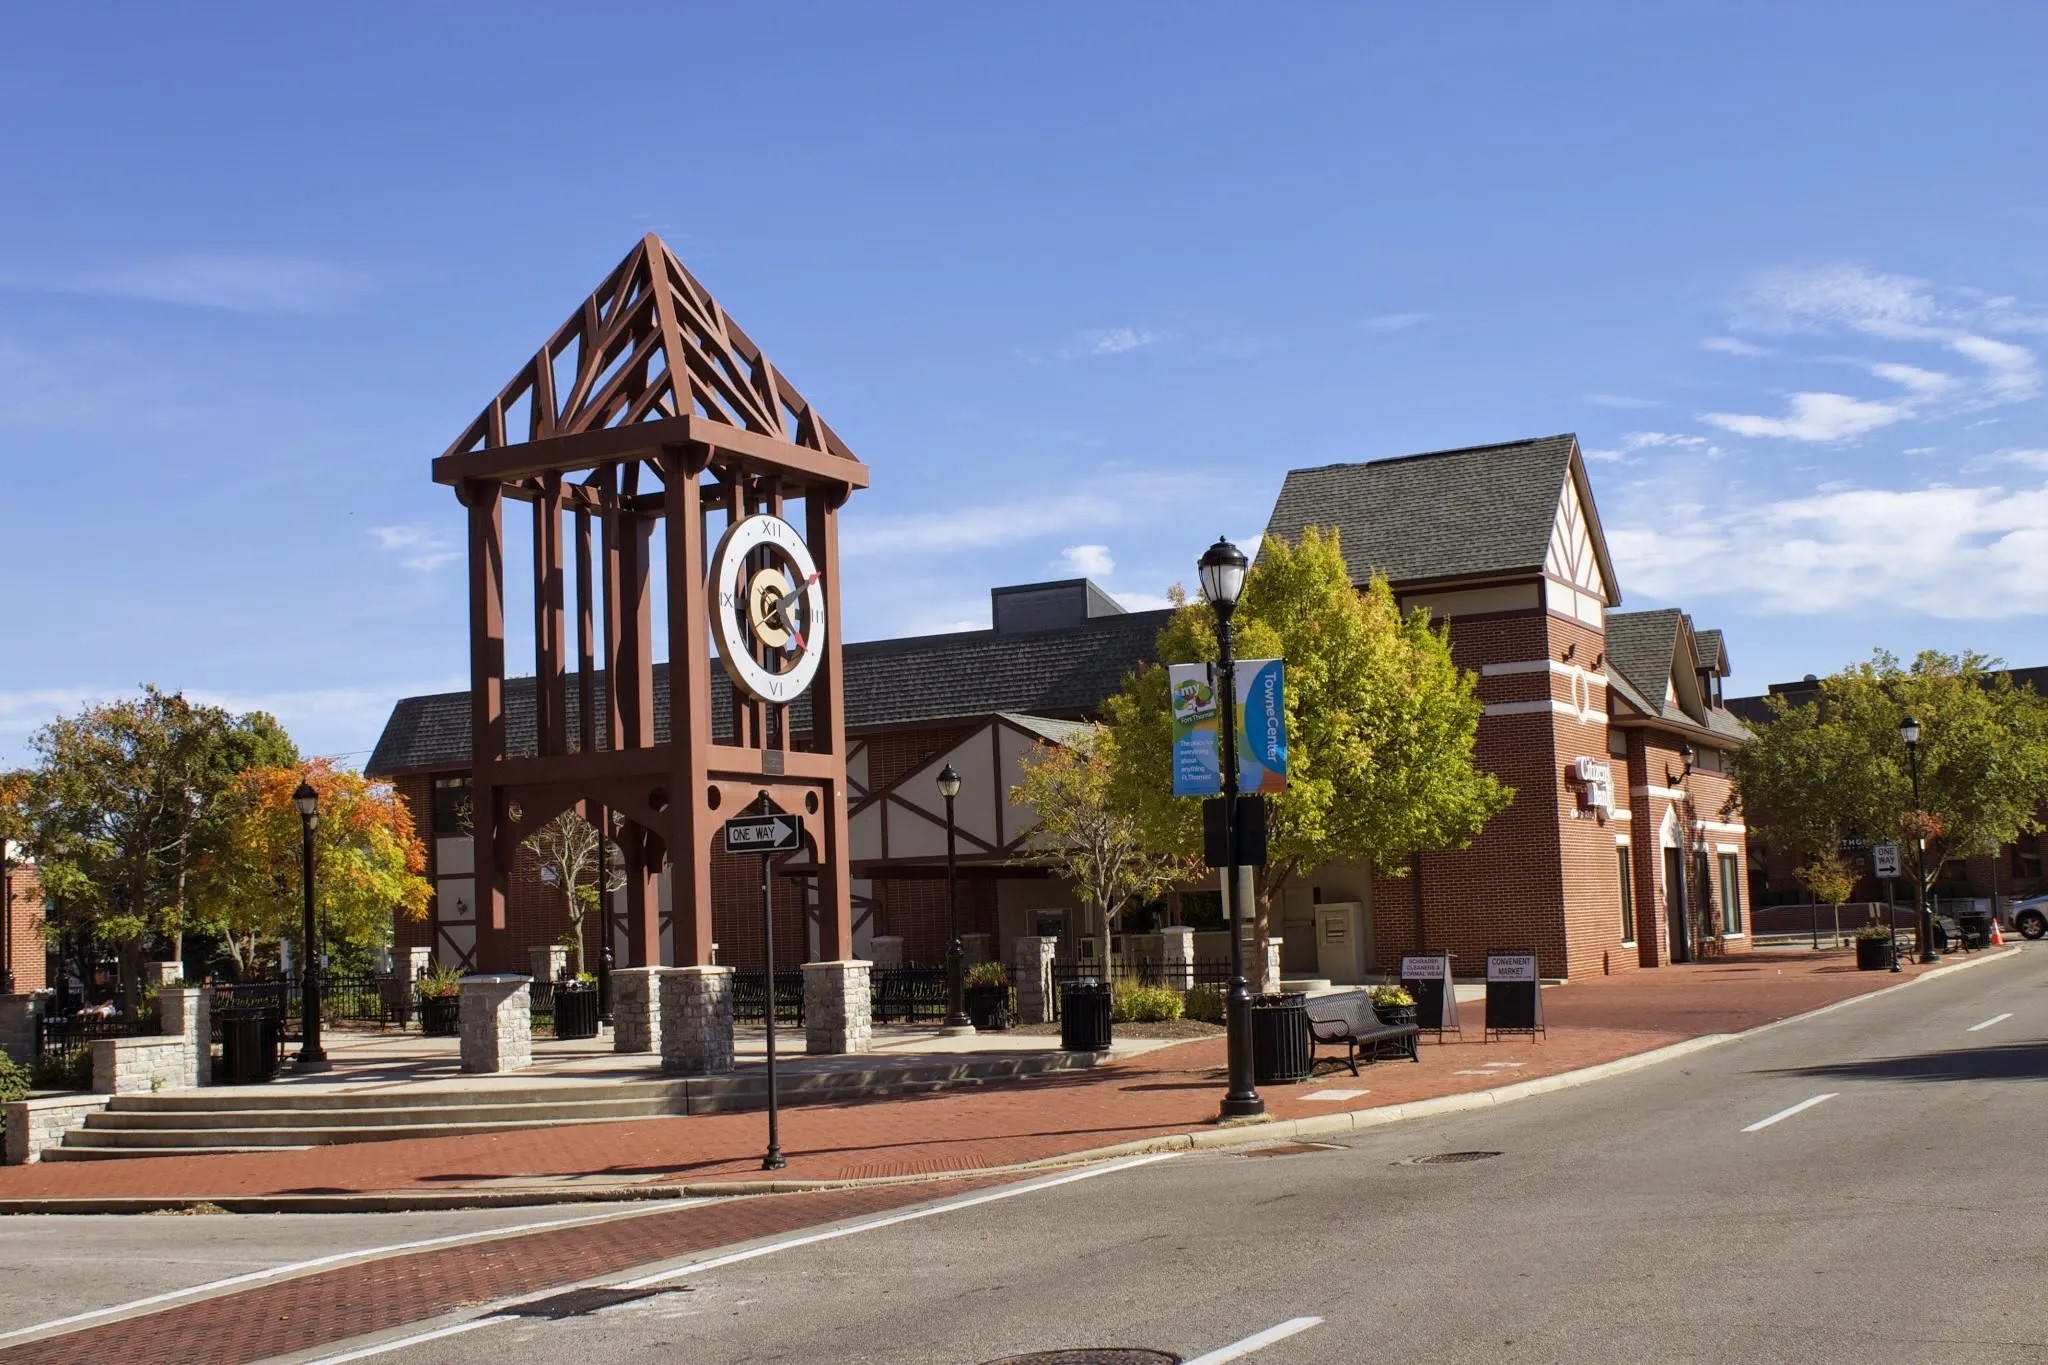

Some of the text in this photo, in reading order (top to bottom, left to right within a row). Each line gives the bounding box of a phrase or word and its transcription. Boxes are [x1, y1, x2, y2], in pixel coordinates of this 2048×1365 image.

[762, 520, 781, 537] XII
[720, 591, 733, 608] IX
[811, 609, 824, 624] III
[769, 680, 783, 696] VI
[1180, 711, 1215, 724] Fort Thomas
[732, 826, 775, 841] ONE WAY
[1878, 848, 1895, 856] ONE
[1878, 856, 1895, 864] WAY
[1491, 957, 1530, 965] CONVENIENT
[1498, 967, 1524, 975] MARKET
